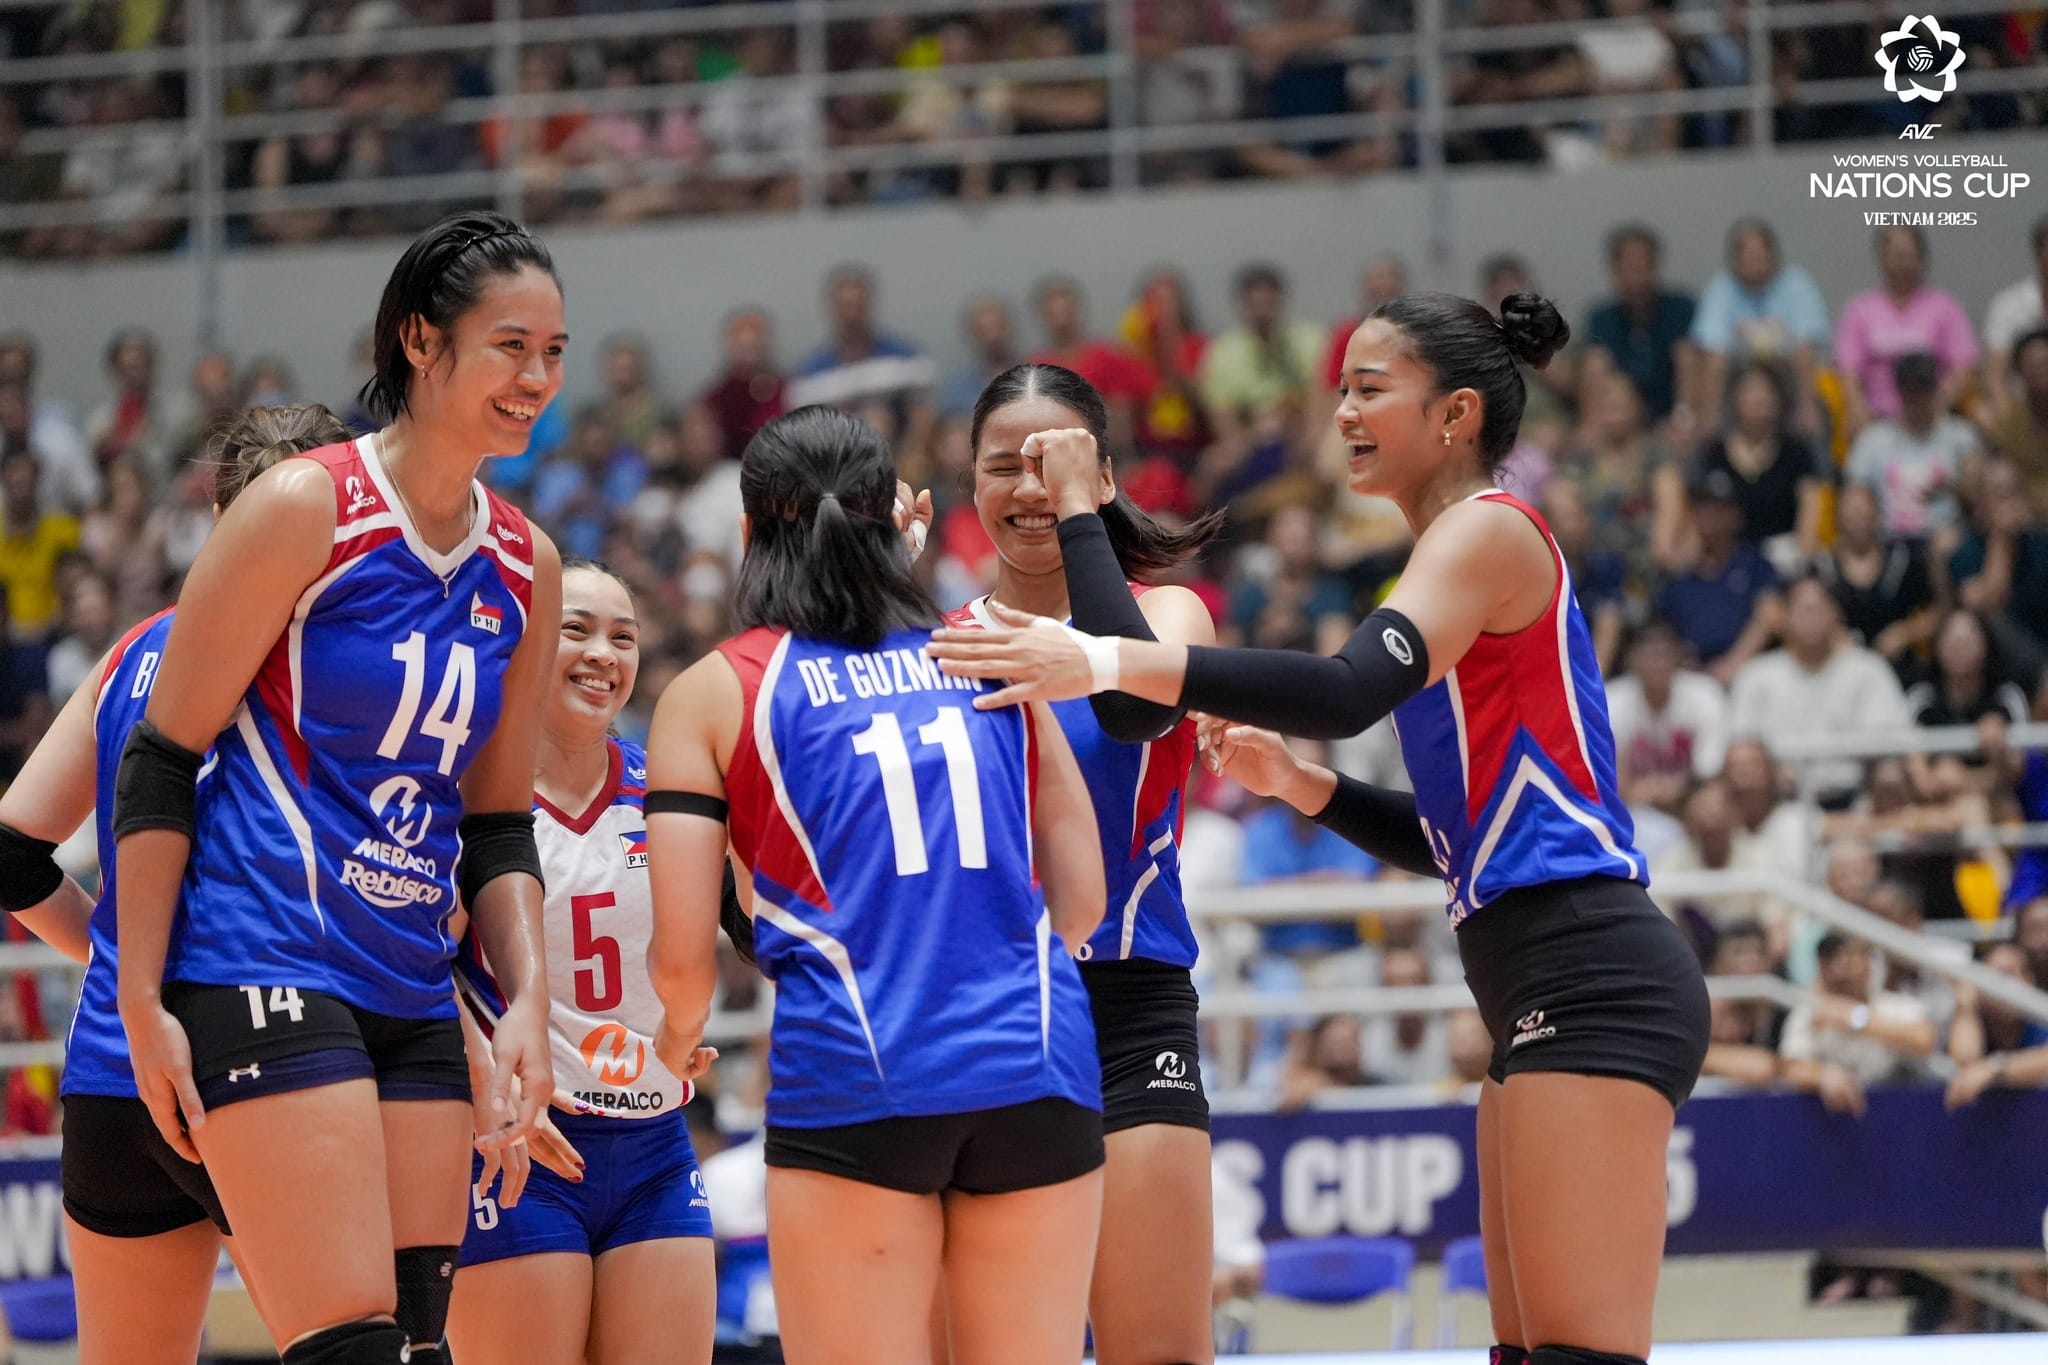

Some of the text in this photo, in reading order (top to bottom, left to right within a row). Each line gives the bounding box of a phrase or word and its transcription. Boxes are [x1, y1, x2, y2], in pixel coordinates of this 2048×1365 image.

[473, 615, 499, 632] PHI
[131, 651, 160, 699] B
[797, 657, 847, 708] DE
[376, 631, 476, 777] 14
[852, 706, 988, 876] 11
[339, 859, 443, 908] Rebisco
[628, 853, 648, 866] PH
[571, 891, 623, 1013] 5
[239, 985, 305, 1030] 14
[1147, 1079, 1196, 1092] MERALCO
[472, 1182, 499, 1231] 5
[1281, 1133, 1464, 1237] CUP
